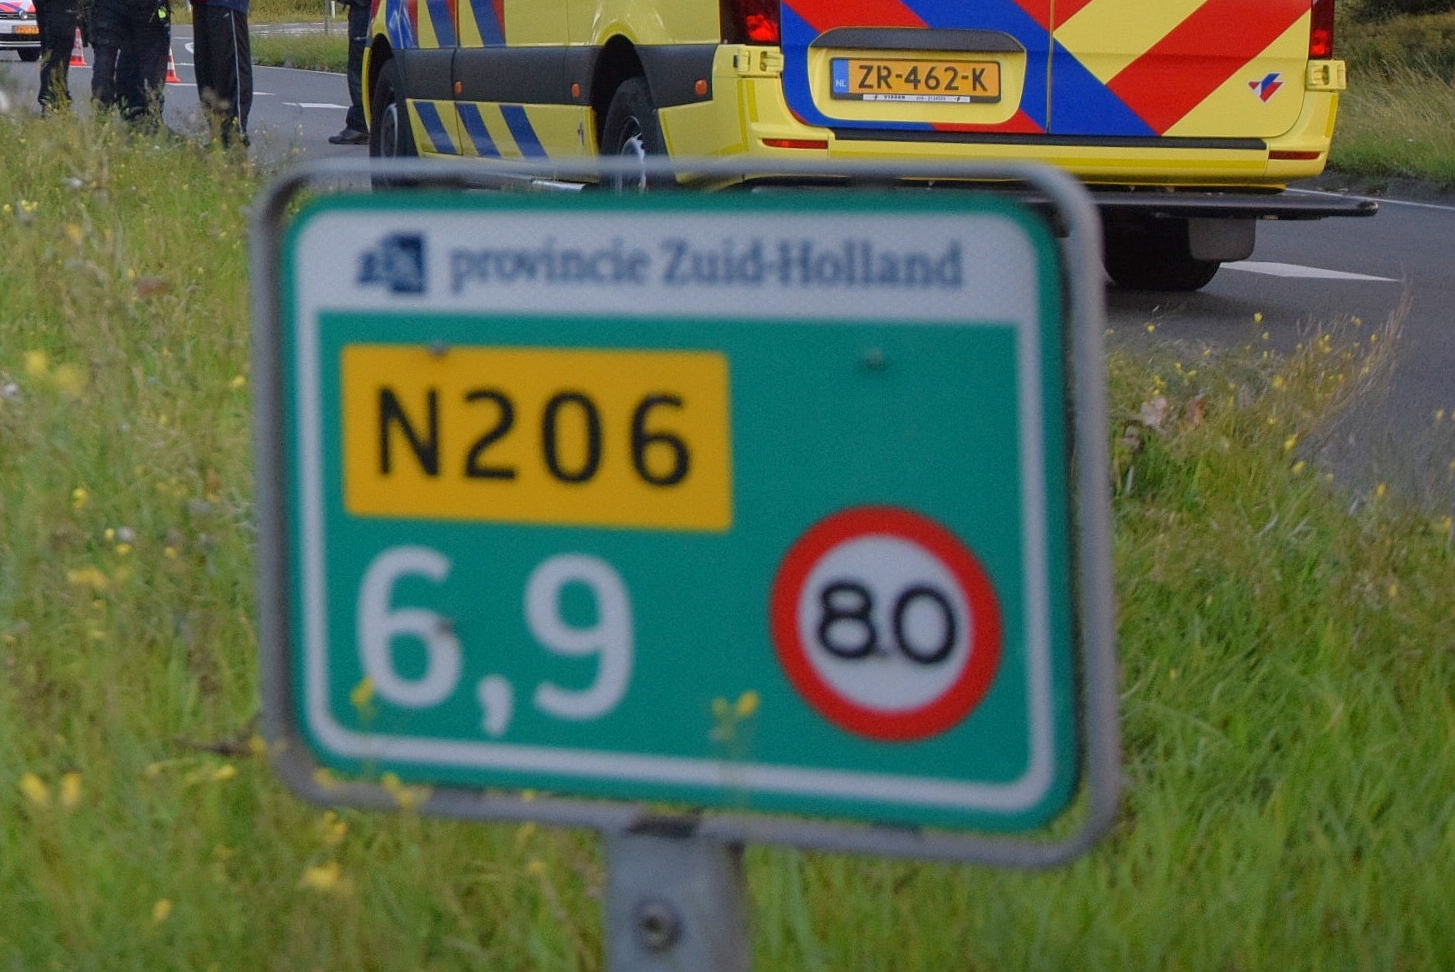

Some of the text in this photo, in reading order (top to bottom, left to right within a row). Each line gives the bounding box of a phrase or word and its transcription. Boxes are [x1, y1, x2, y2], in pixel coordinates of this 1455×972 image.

[835, 64, 988, 92] NL ZR-462-K
[449, 237, 964, 294] provincie Zuid-Holland
[378, 387, 692, 488] N206
[357, 544, 635, 736] 6,9
[818, 582, 956, 664] 80
